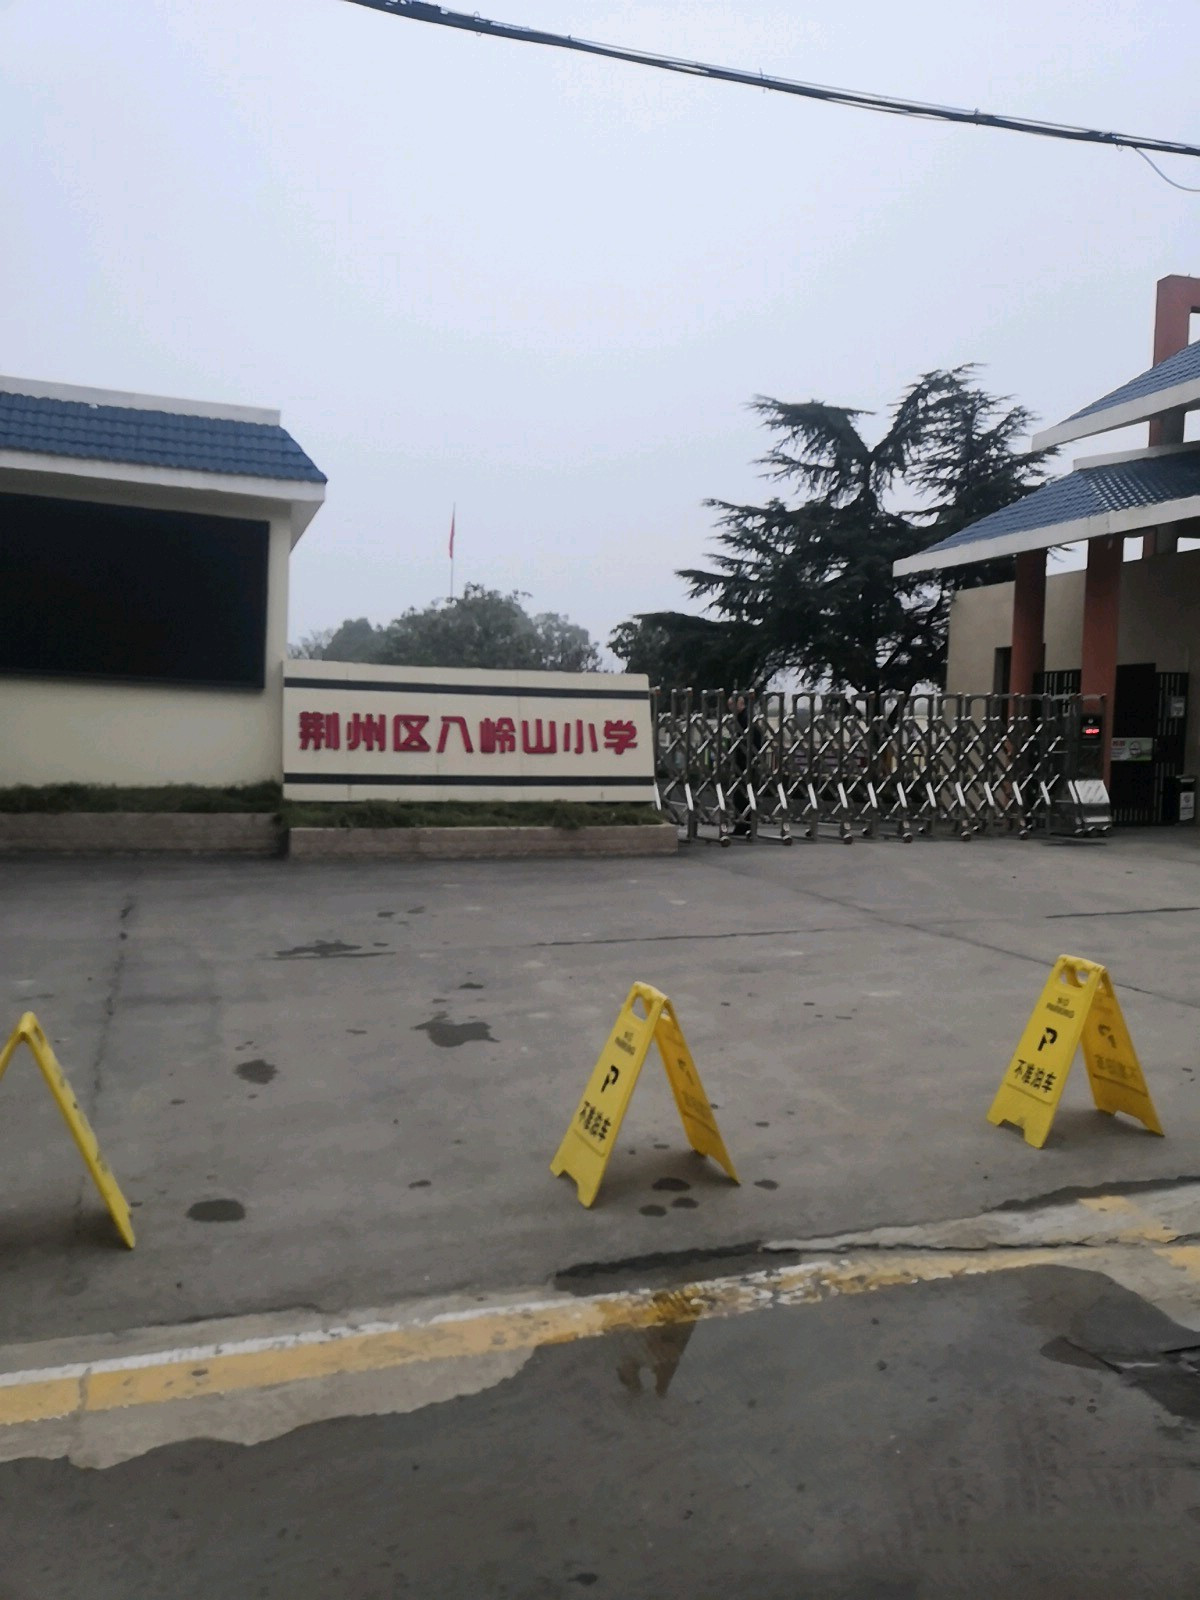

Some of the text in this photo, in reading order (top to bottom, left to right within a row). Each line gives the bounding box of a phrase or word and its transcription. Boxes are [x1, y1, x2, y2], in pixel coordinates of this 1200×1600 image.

[299, 711, 638, 755] 荆州区八岭山小学
[1037, 1027, 1058, 1052] P
[601, 1065, 620, 1093] P
